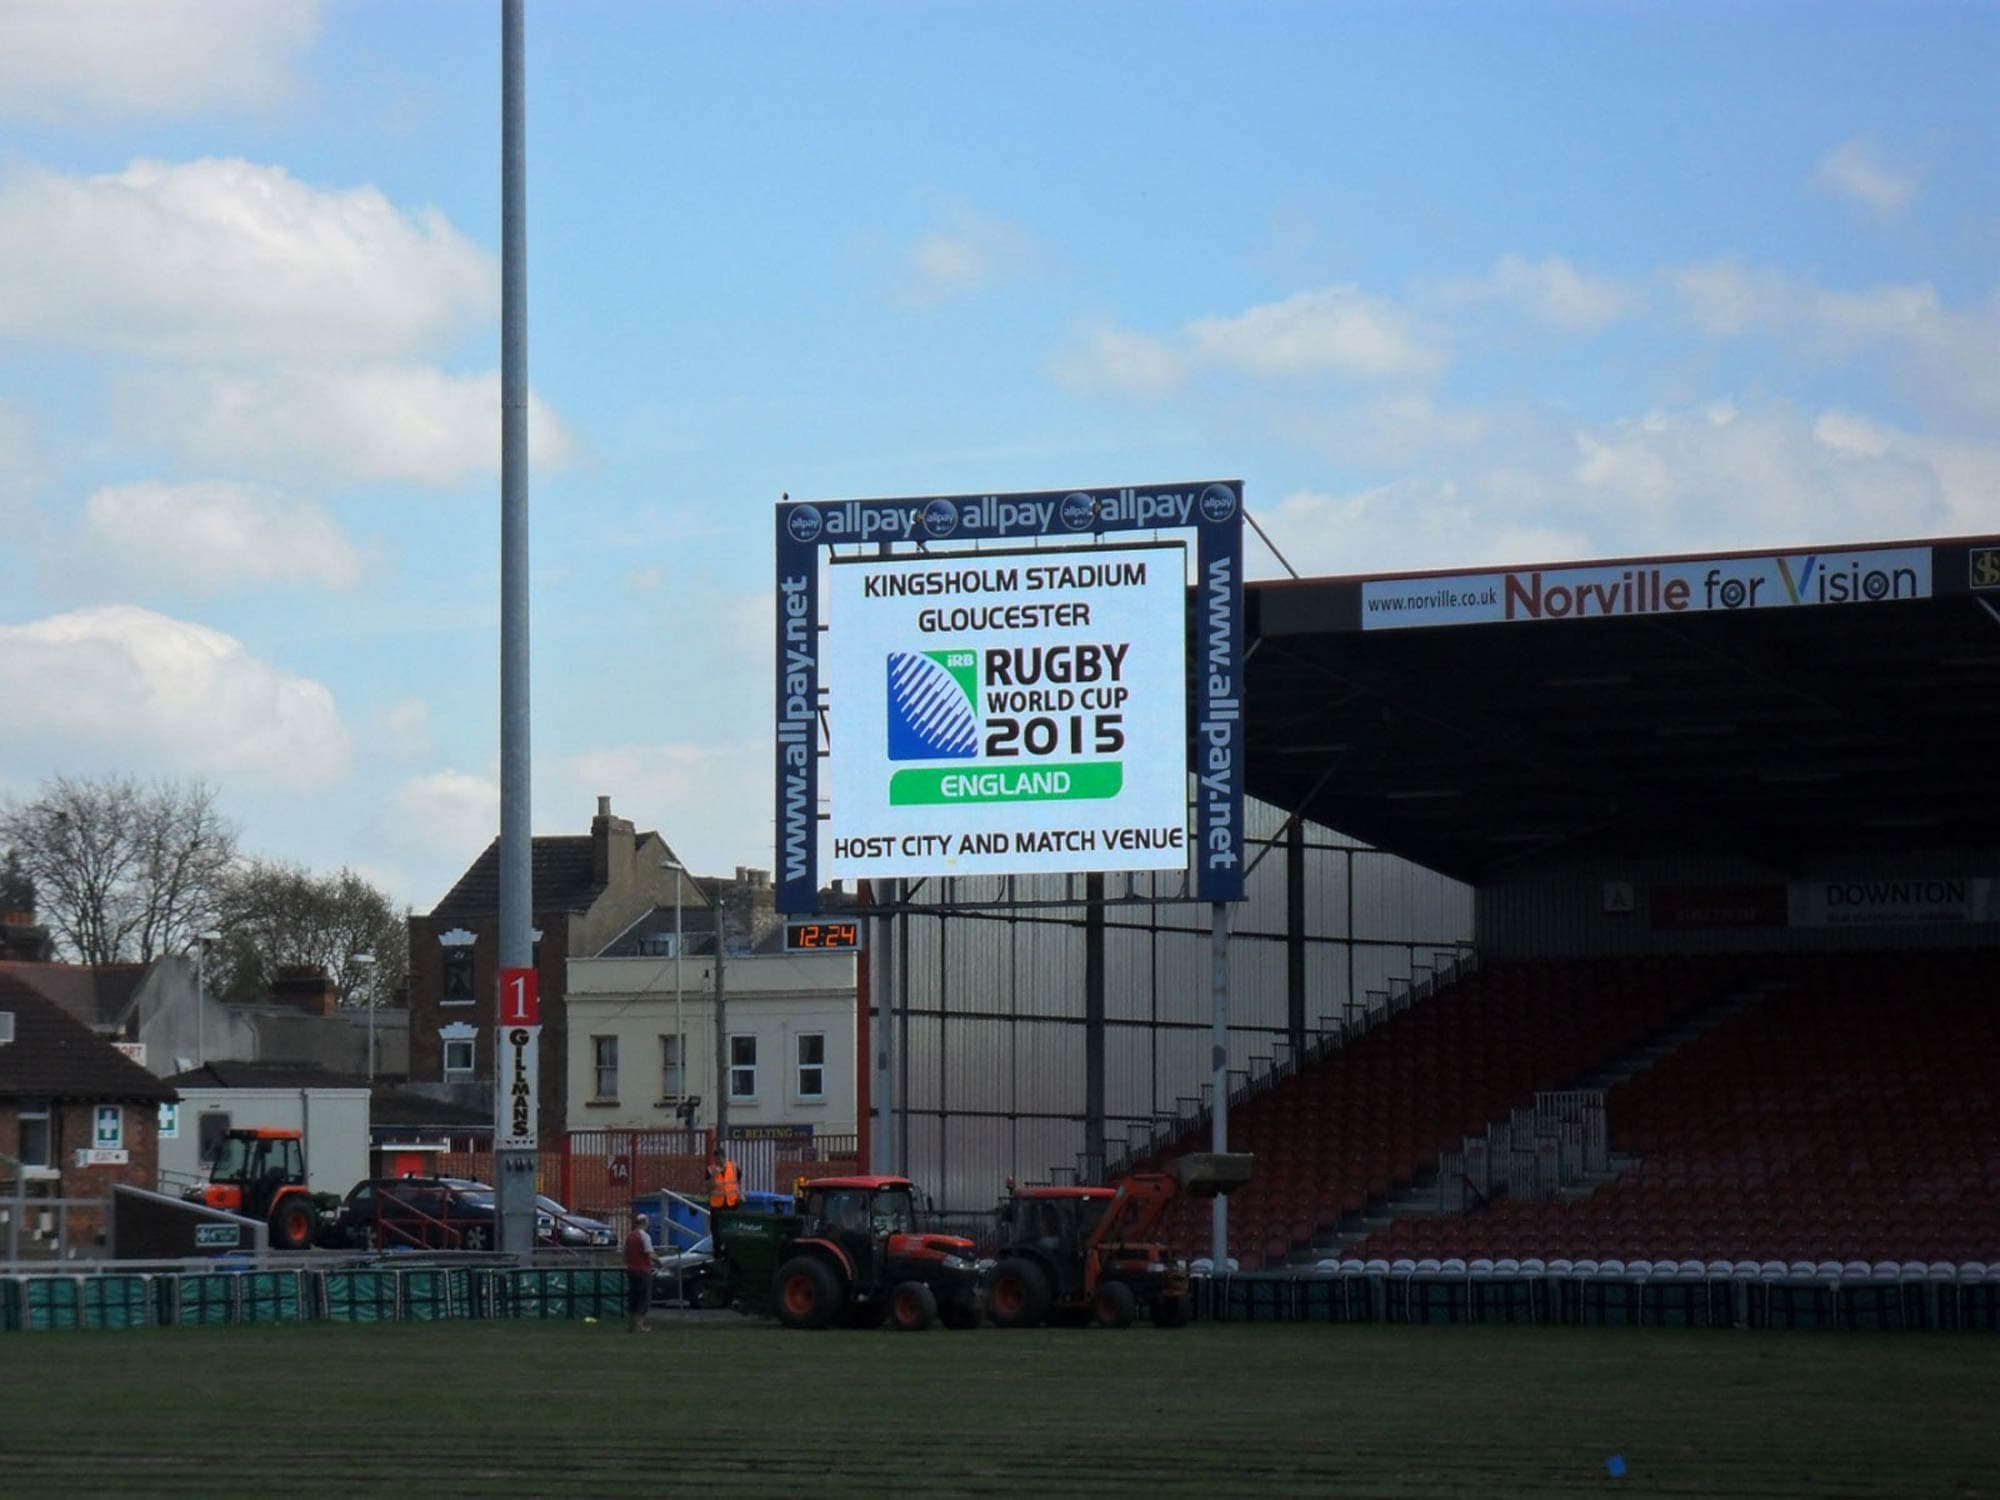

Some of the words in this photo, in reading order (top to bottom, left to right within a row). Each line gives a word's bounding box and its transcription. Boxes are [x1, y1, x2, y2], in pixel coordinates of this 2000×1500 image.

[826, 502, 917, 540] allpay
[962, 496, 1054, 535] allpay
[1100, 488, 1194, 527] allpay
[864, 568, 1018, 598] KINGSHOLM
[1026, 563, 1147, 590] STADIUM
[1368, 586, 1497, 612] www.norville.co.uk
[1505, 570, 1690, 619] Norville
[1704, 569, 1765, 609] for
[1777, 557, 1918, 604] Vision
[918, 603, 1090, 632] GLOUCESTER
[985, 643, 1130, 686] RUGBY
[986, 689, 1077, 713] WORLD
[1081, 687, 1129, 710] CUP
[1200, 557, 1238, 870] www.allpay.net
[779, 575, 816, 881] www.allpay.net
[985, 714, 1125, 757] 2015
[940, 771, 1071, 797] ENGLAND
[834, 836, 896, 858] HOST
[902, 834, 952, 856] CITY
[959, 832, 1009, 854] AND
[1016, 830, 1095, 852] MATCH
[1102, 827, 1184, 850] VENUE
[1826, 881, 1966, 906] DOWNTON
[510, 975, 529, 1018] 1
[509, 1028, 530, 1136] GILLMANS
[612, 1163, 628, 1179] 1A
